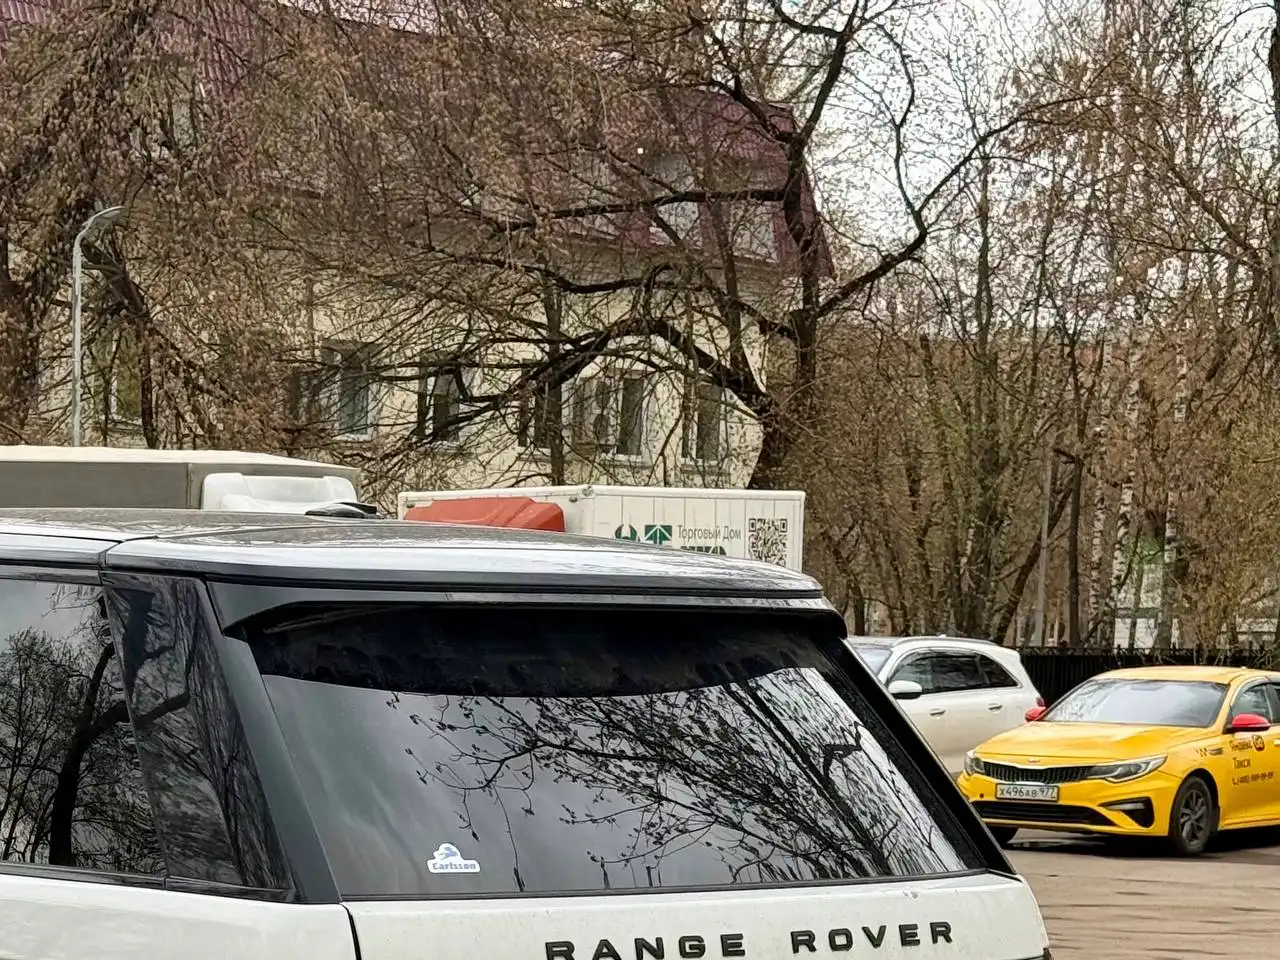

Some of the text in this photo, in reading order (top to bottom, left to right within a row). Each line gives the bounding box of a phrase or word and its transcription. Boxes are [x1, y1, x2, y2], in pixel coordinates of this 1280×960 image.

[677, 524, 741, 541] Торговый Дом
[432, 861, 477, 871] Carlsson
[790, 921, 953, 954] ROVER
